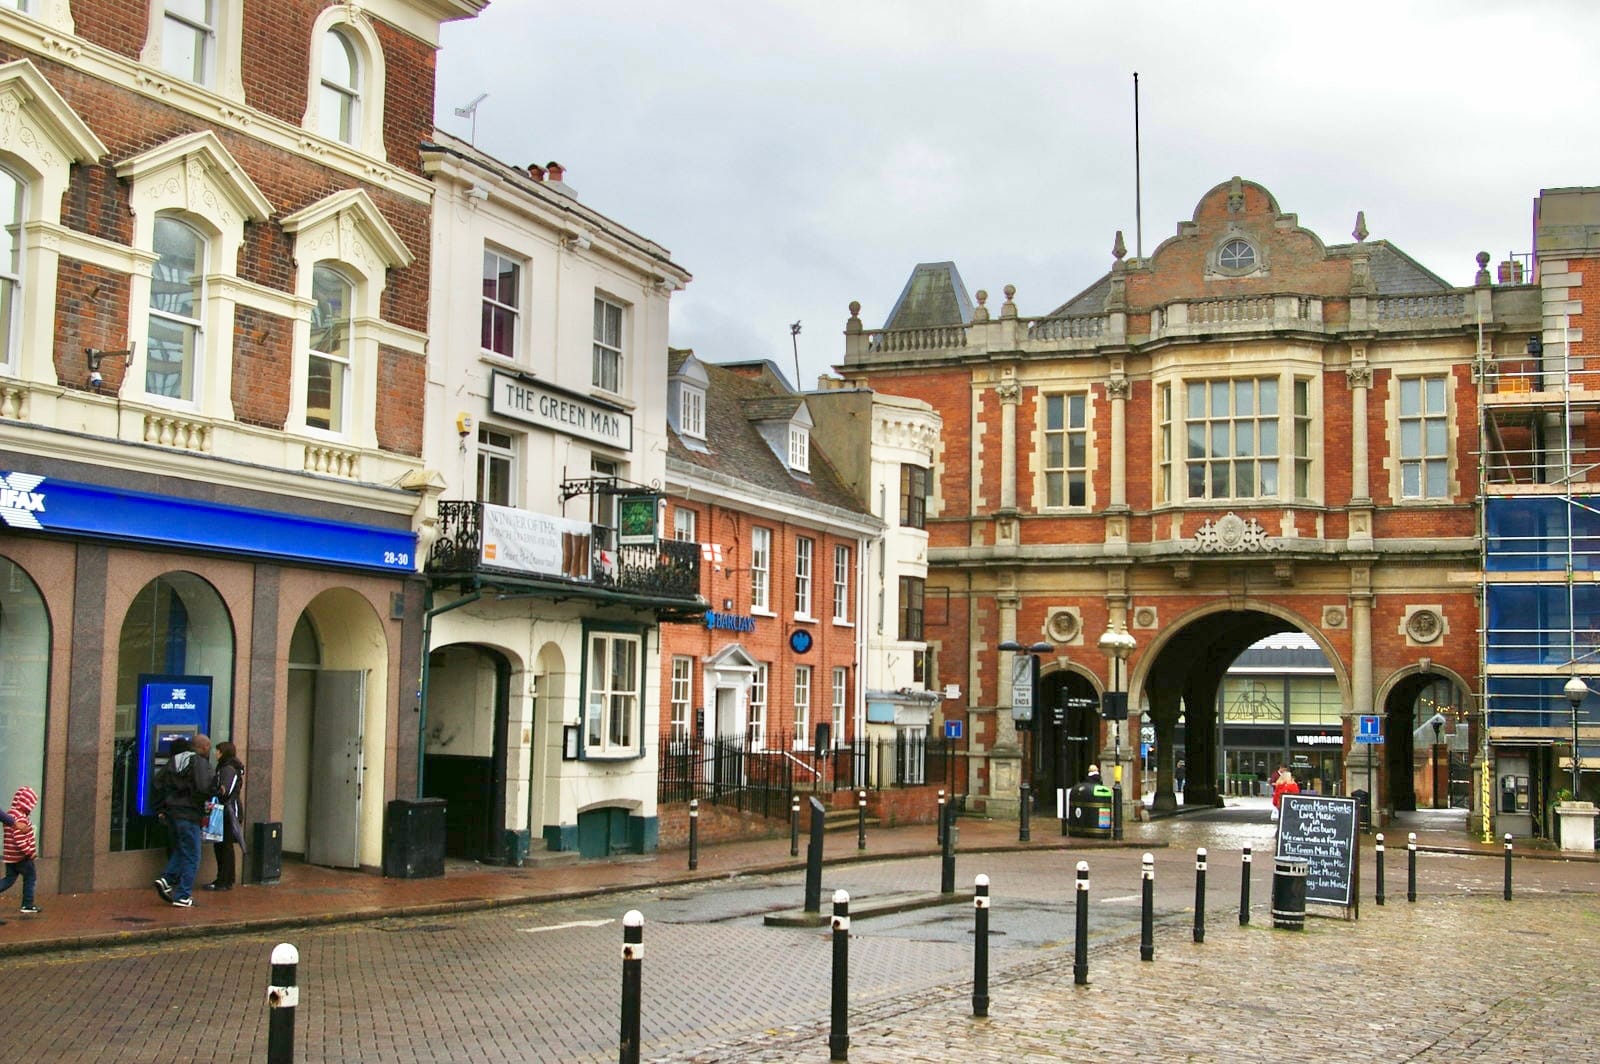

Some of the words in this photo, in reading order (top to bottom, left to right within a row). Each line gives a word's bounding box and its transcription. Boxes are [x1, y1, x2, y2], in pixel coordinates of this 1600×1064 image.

[506, 384, 534, 412] THE
[539, 395, 586, 430] GREEN
[591, 410, 620, 438] MAN
[0, 488, 46, 512] IFAX
[384, 551, 408, 566] 28-30
[715, 612, 756, 632] BARCLAYS
[1290, 800, 1312, 810] Green
[1313, 800, 1327, 811] Man
[1328, 802, 1351, 814] Events
[1299, 810, 1314, 819] Live
[1316, 811, 1336, 820] Music
[1282, 832, 1292, 840] We
[1300, 822, 1336, 839] Aylesbury
[1284, 843, 1296, 853] The
[1296, 844, 1313, 854] Green
[1314, 846, 1328, 856] Man
